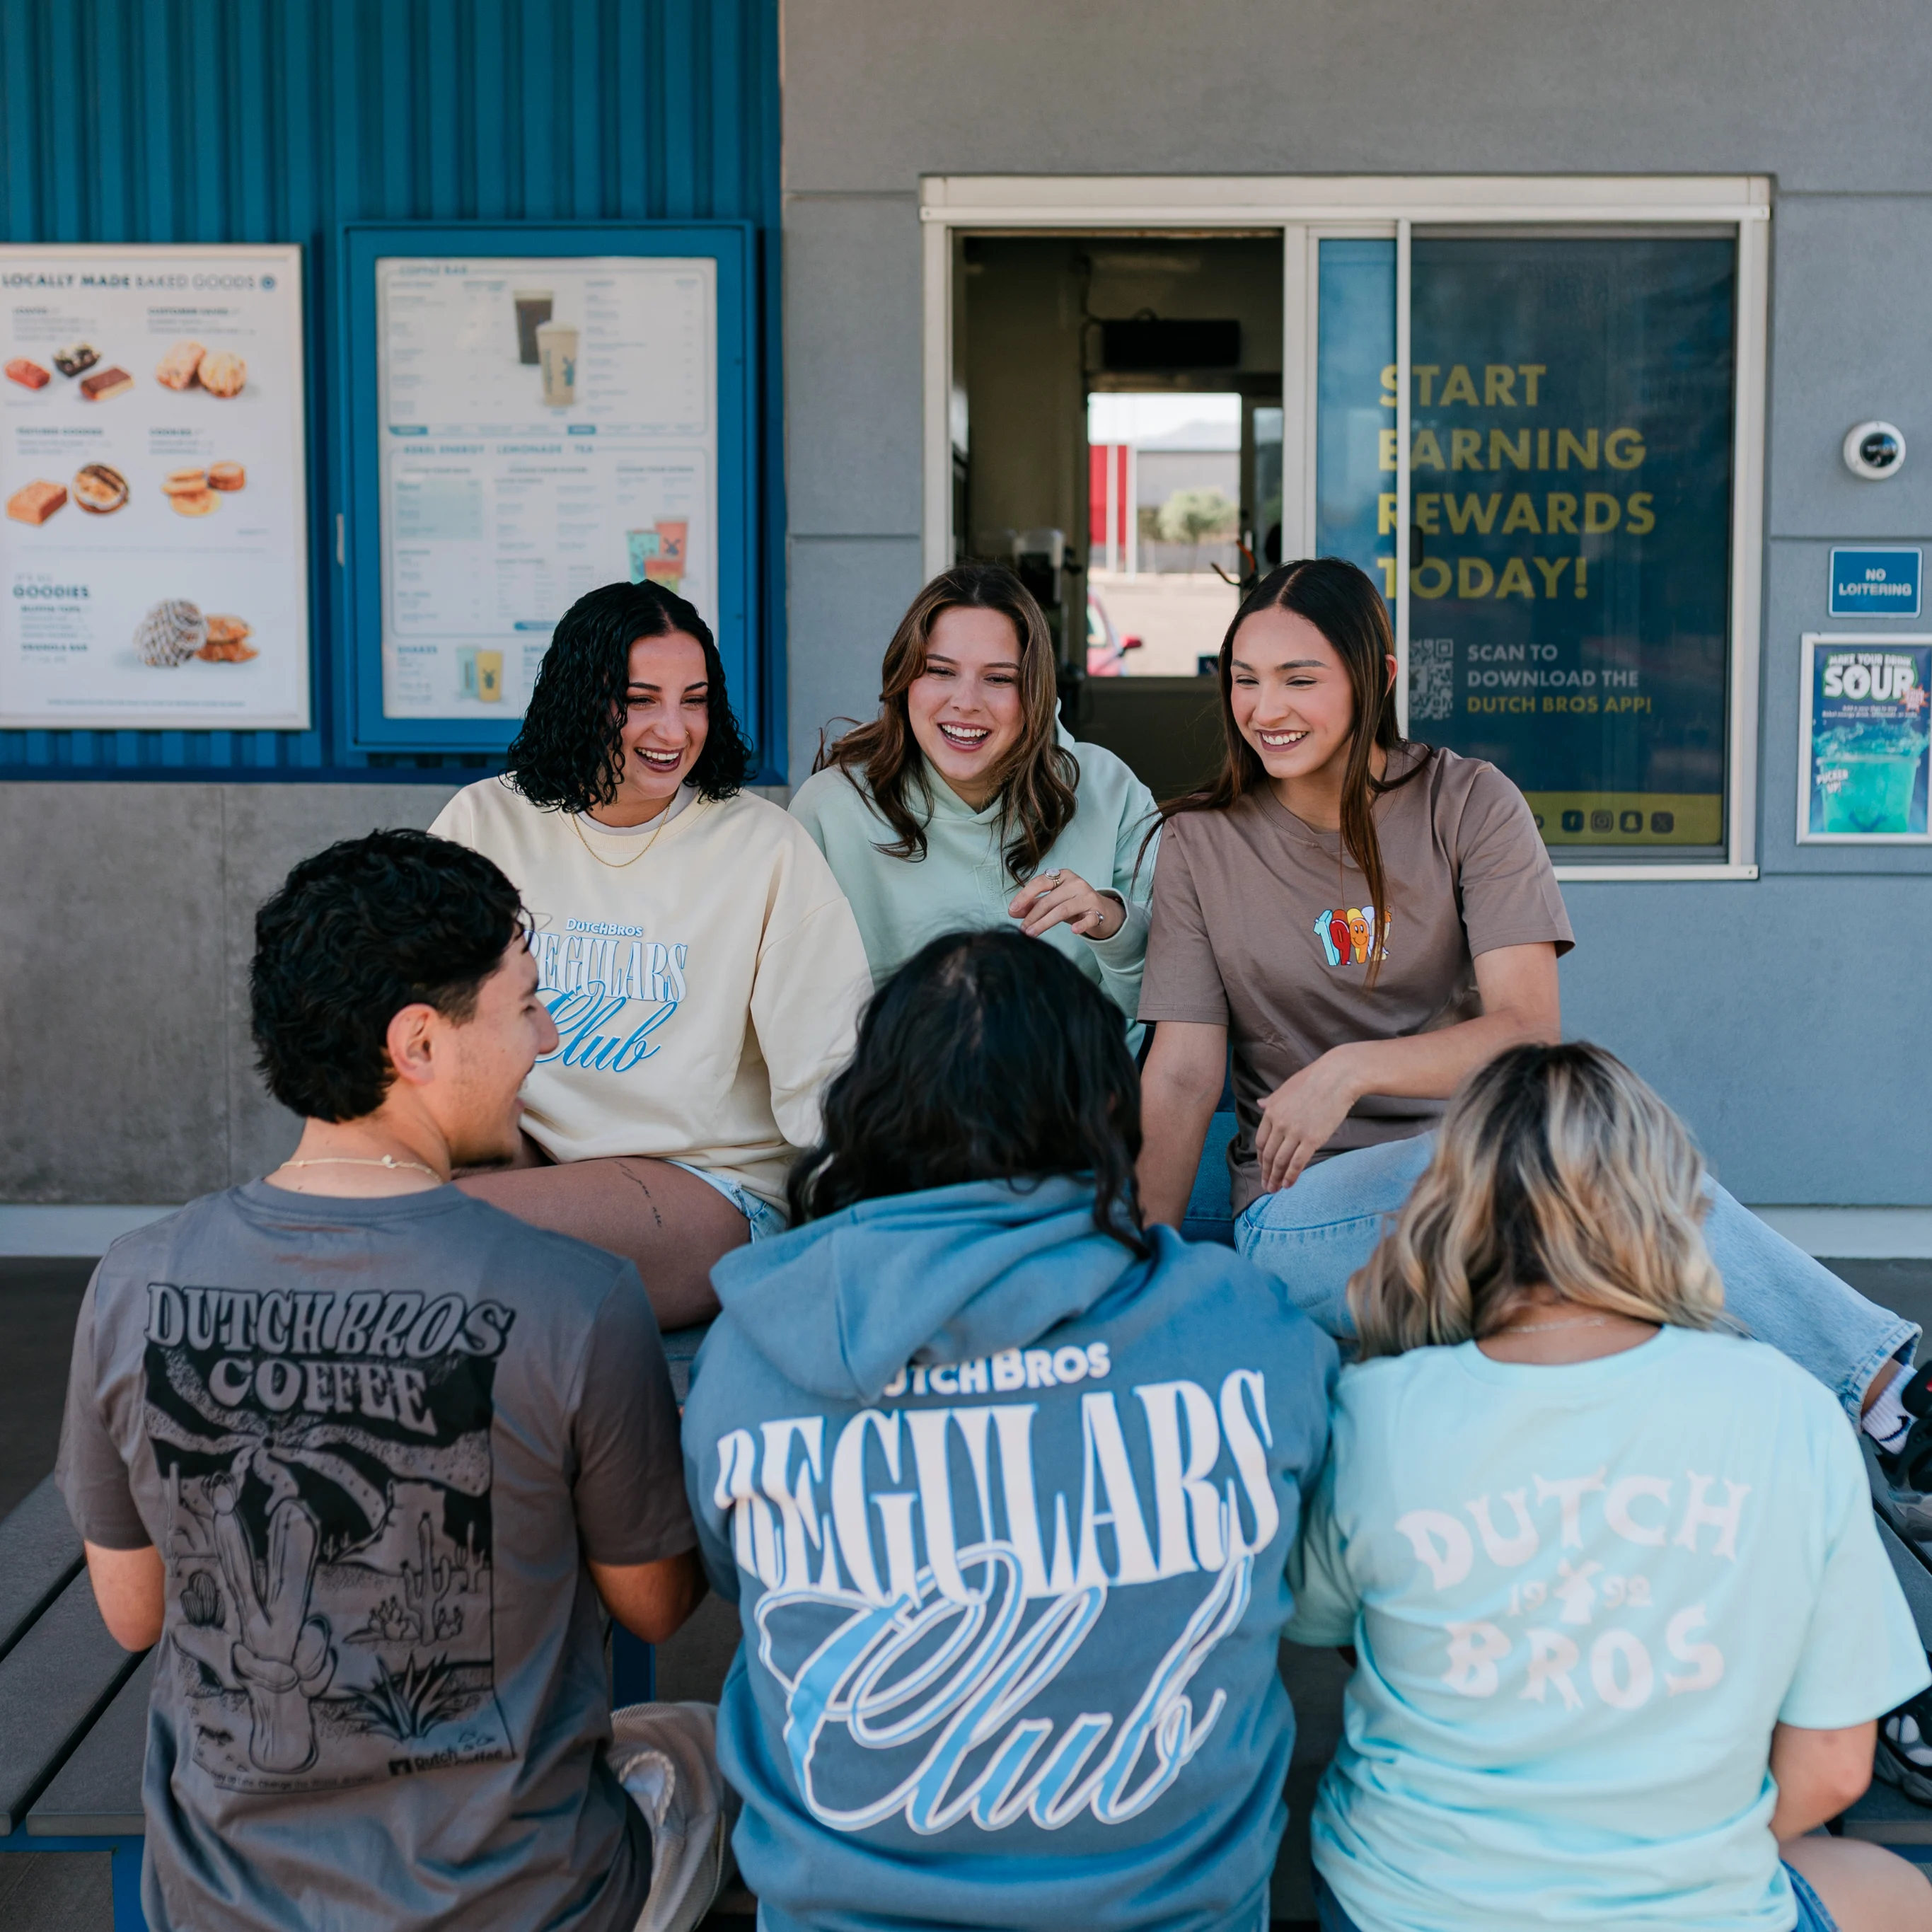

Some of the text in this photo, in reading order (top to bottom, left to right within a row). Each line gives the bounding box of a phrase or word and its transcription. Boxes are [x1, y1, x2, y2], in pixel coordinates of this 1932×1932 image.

[2, 274, 255, 290] LOCALLY MADE BAKED GOODS
[1379, 364, 1546, 407] START
[1378, 427, 1646, 471] EARNING
[1377, 492, 1656, 536] REWARDS
[13, 584, 90, 599] GOODIES
[1376, 557, 1588, 600] TODAY!
[1839, 583, 1911, 596] LOITERING
[1866, 568, 1886, 581] NO
[1467, 644, 1558, 662] SCAN TO
[1828, 654, 1856, 665] MAKE
[1857, 653, 1883, 665] YOUR
[1467, 670, 1638, 688] DOWNLOAD THE
[1824, 664, 1915, 700] SOUR
[1467, 696, 1652, 713] DUTCH BROS APP!
[1816, 769, 1849, 785] PUCKER
[209, 1358, 437, 1437] COFFEE
[1394, 1465, 1752, 1591] DUTCH
[1508, 1575, 1653, 1616] 19 92
[1441, 1602, 1725, 1711] BROS
[754, 1541, 1254, 1835] Club
